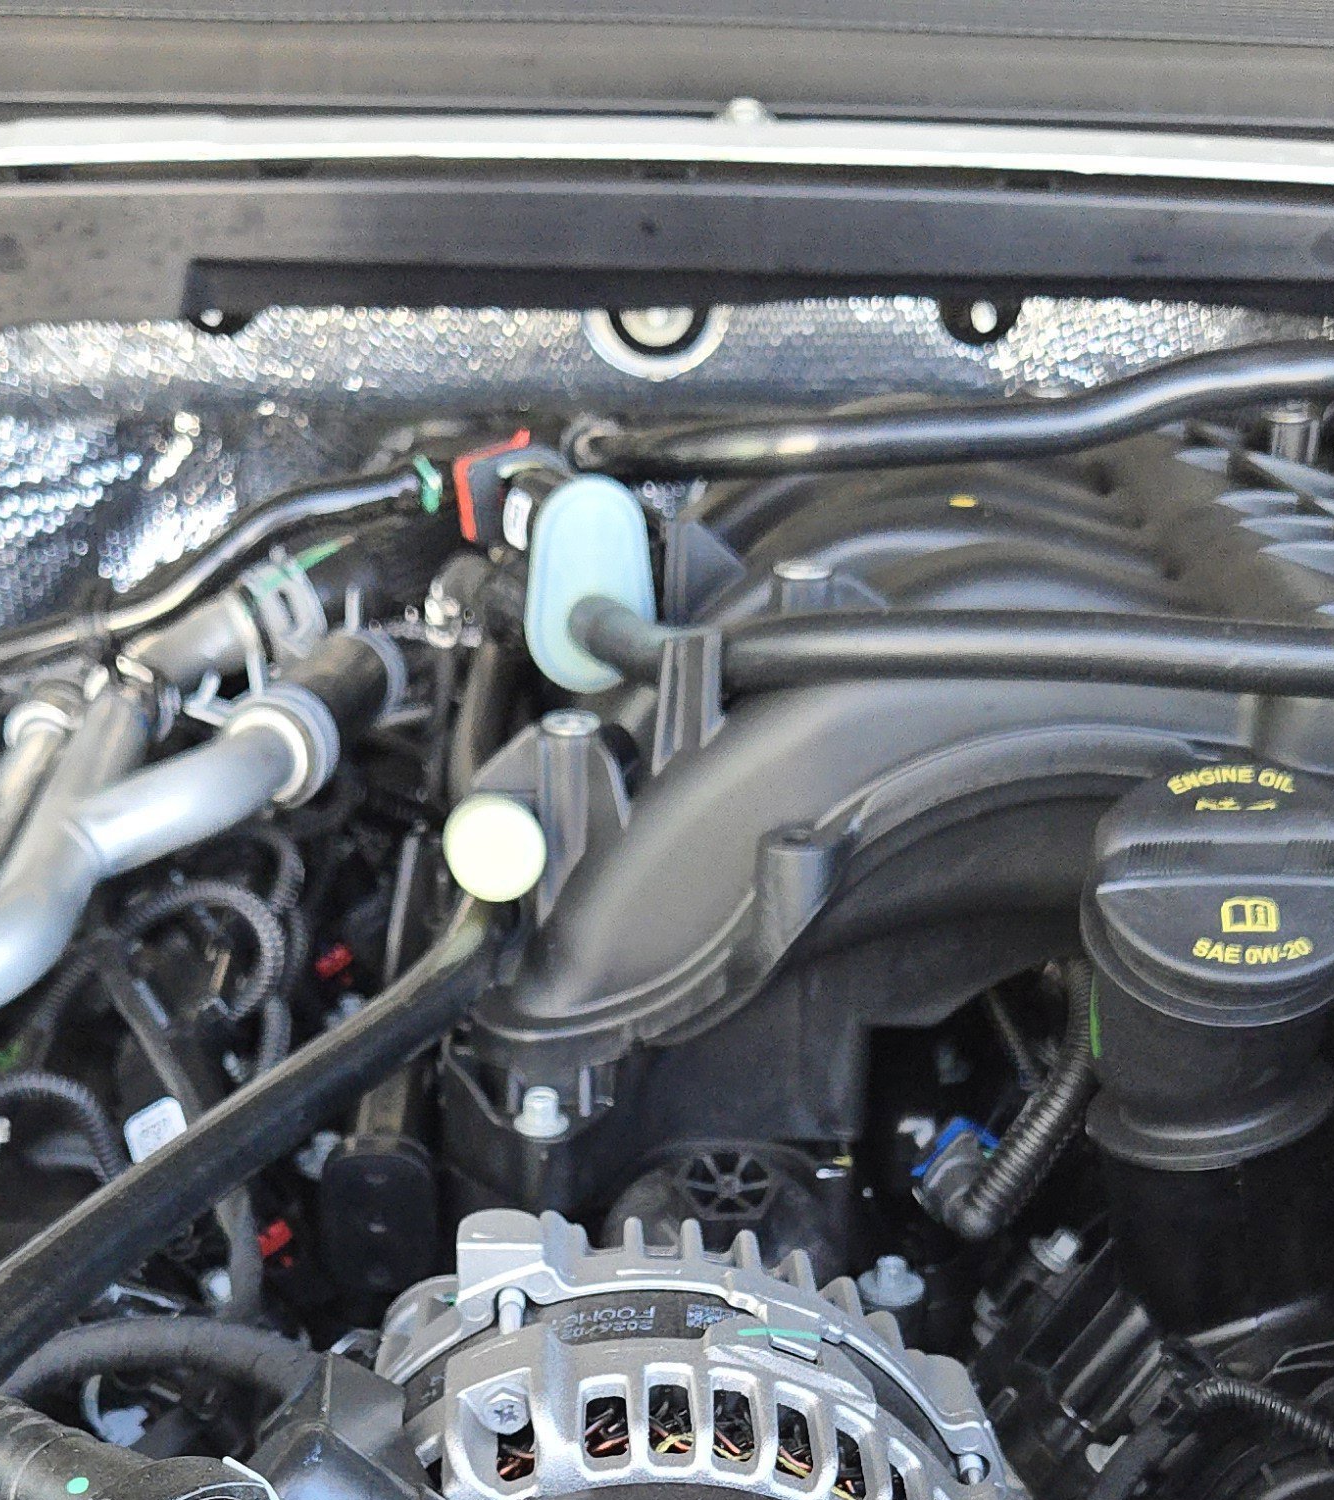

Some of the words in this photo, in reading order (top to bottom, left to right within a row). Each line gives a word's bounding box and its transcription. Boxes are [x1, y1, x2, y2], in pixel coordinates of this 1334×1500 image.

[1167, 764, 1255, 795] ENGINE
[1258, 768, 1297, 794] OIL
[1192, 937, 1241, 964] SAE
[1245, 936, 1314, 966] 0W-20
